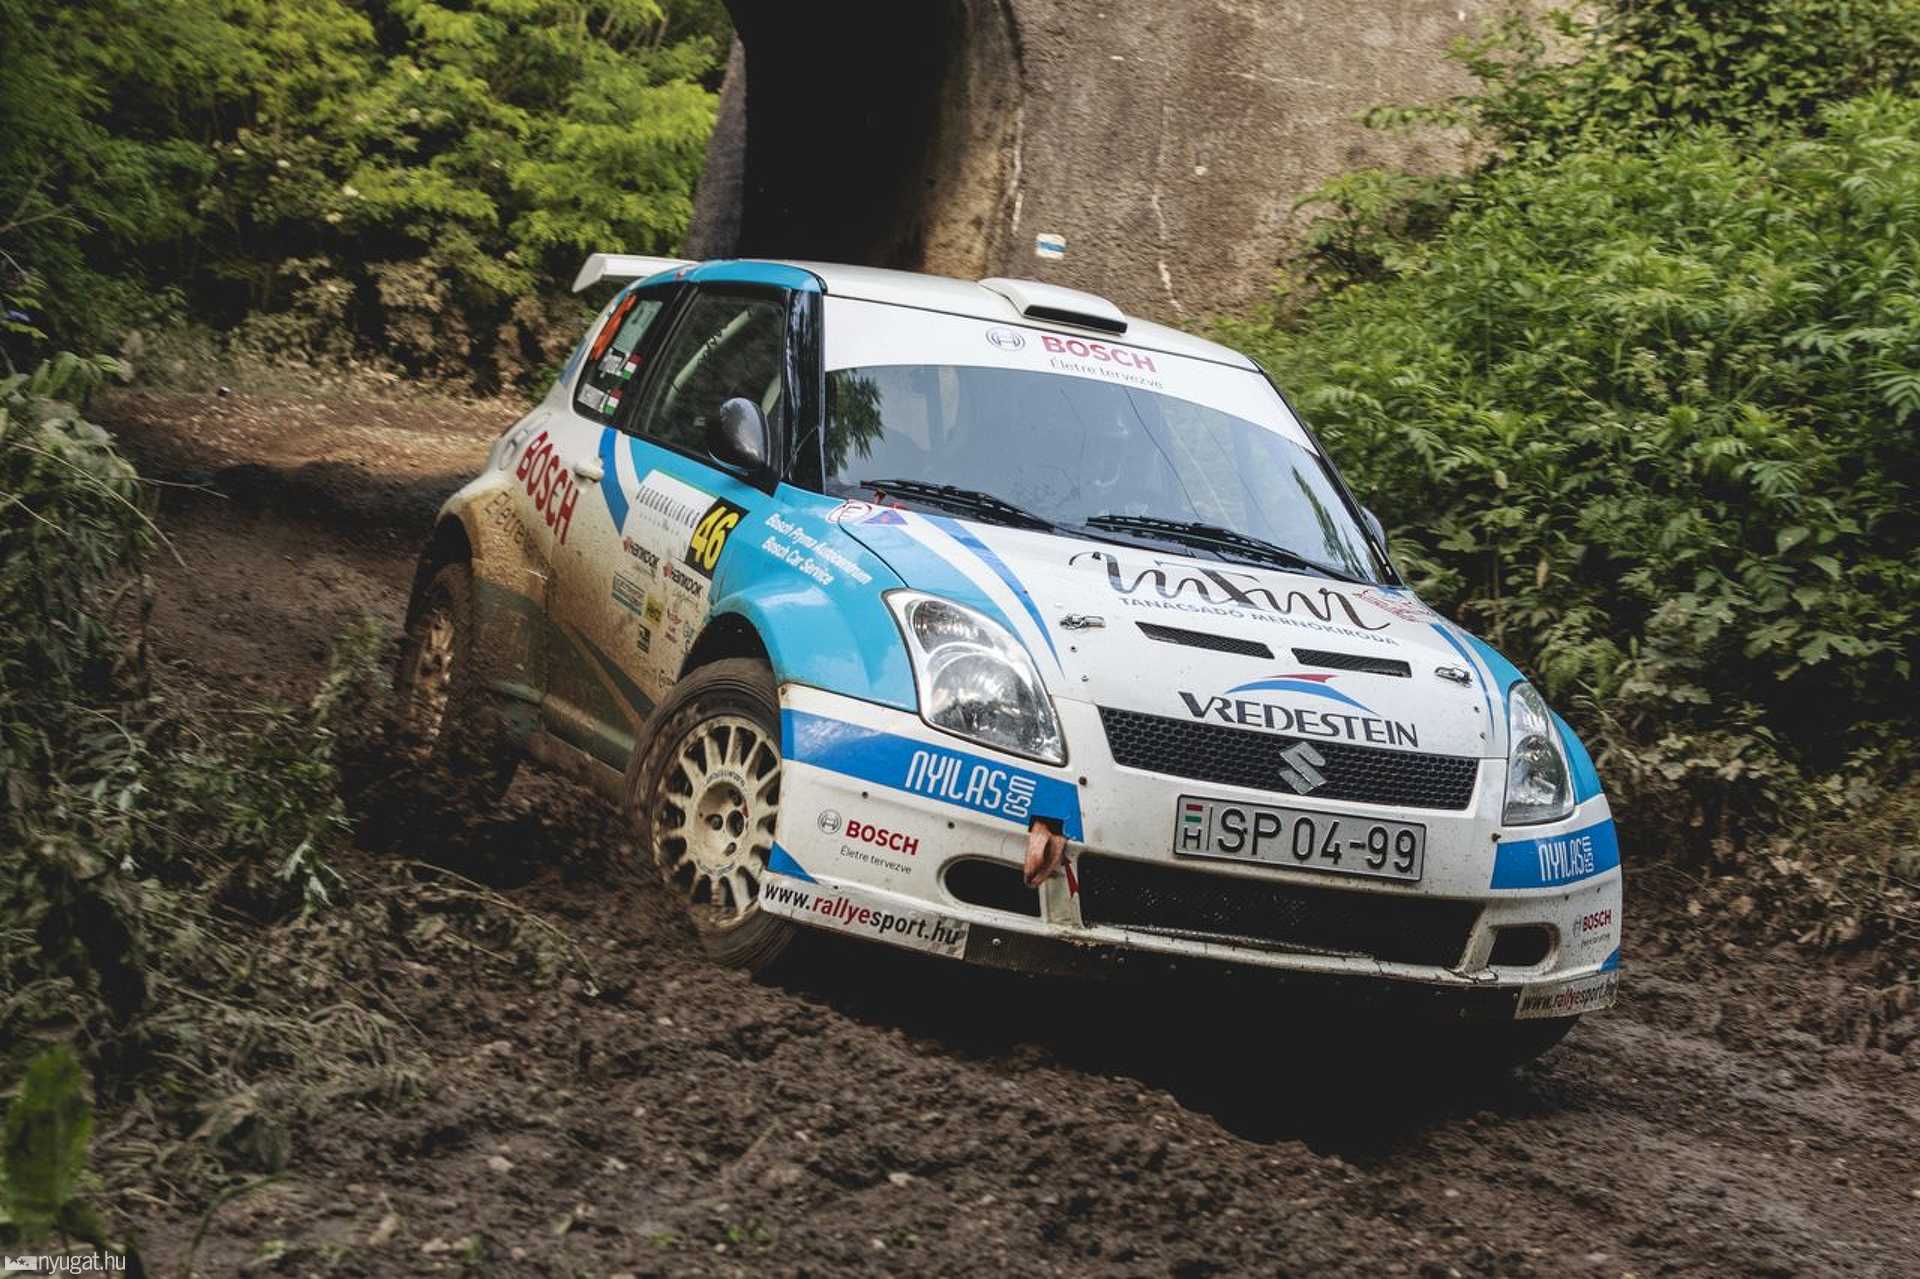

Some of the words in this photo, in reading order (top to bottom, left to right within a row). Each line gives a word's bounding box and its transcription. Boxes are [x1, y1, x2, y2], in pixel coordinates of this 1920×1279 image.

[1041, 335, 1157, 373] BOSCH
[516, 431, 579, 545] BOSCH
[690, 505, 741, 571] 46
[1178, 691, 1419, 748] VREDESTEIN
[904, 750, 1007, 810] NYILAS
[845, 819, 919, 856] BOSCH
[1538, 840, 1585, 882] NYILAS
[764, 883, 960, 946] www.rallyesport.hu
[1582, 909, 1612, 932] BOSCH
